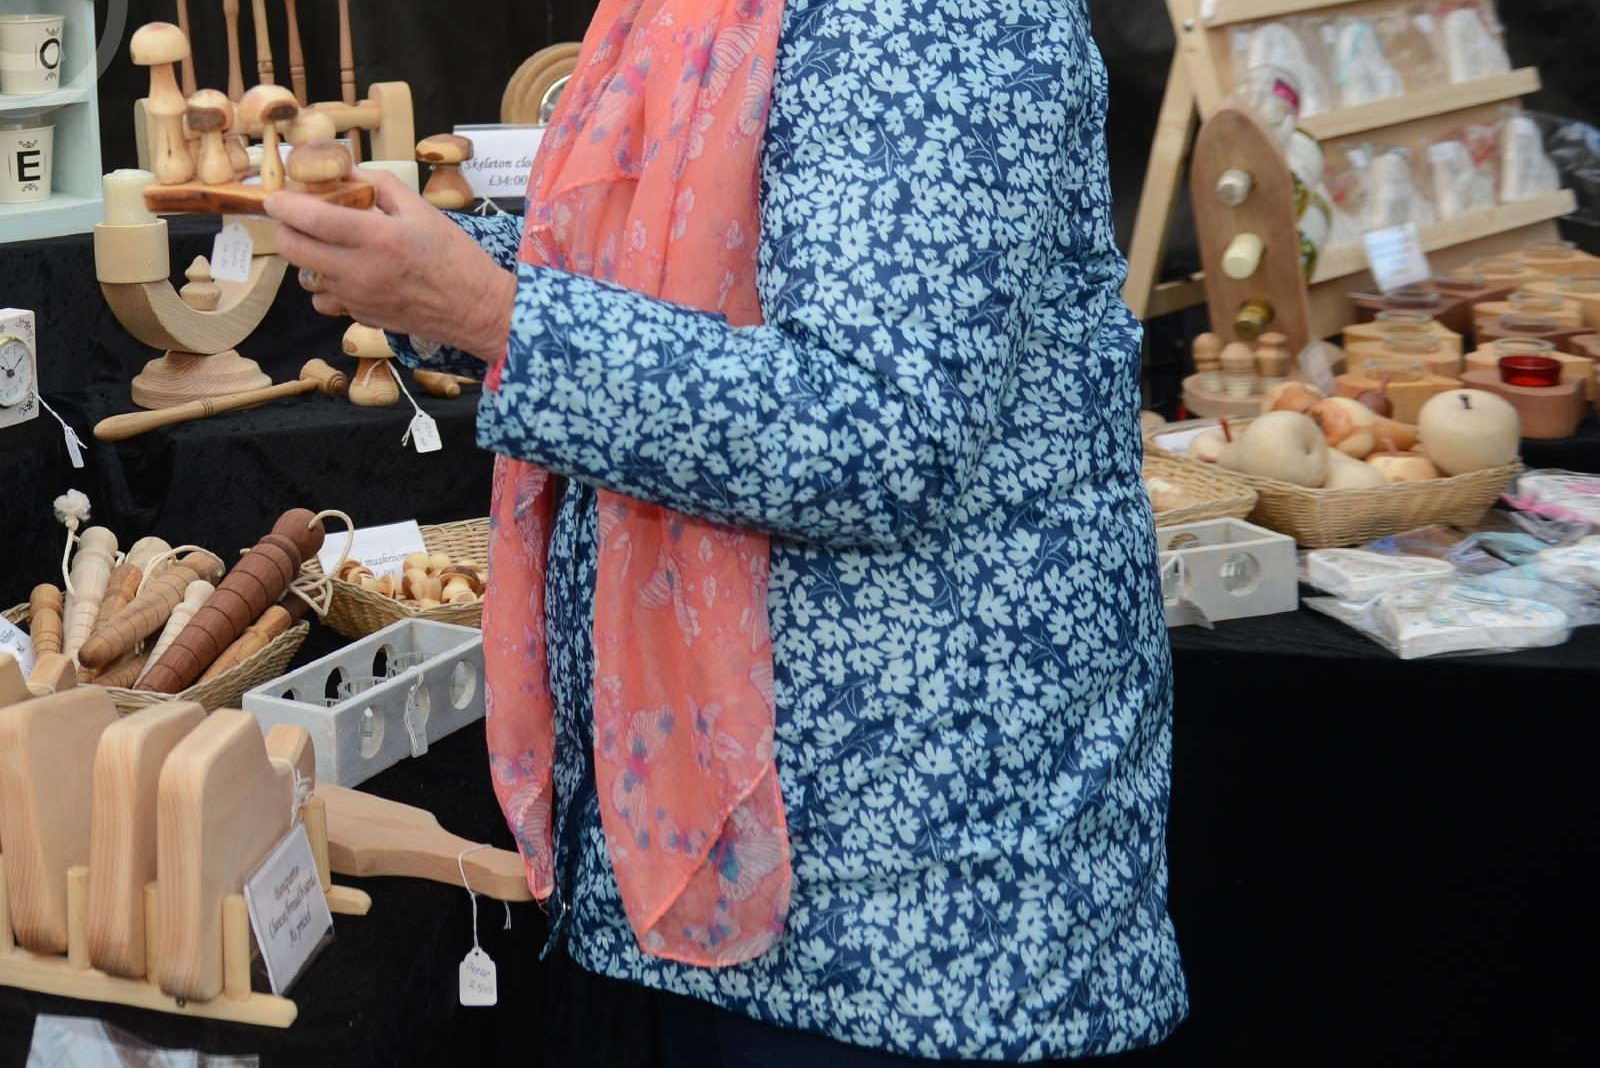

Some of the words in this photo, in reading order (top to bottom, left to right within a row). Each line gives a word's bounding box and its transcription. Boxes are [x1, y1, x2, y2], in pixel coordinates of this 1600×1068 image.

[39, 37, 61, 70] O
[16, 149, 41, 182] E
[464, 155, 512, 171] Skeleton
[515, 155, 532, 169] clo
